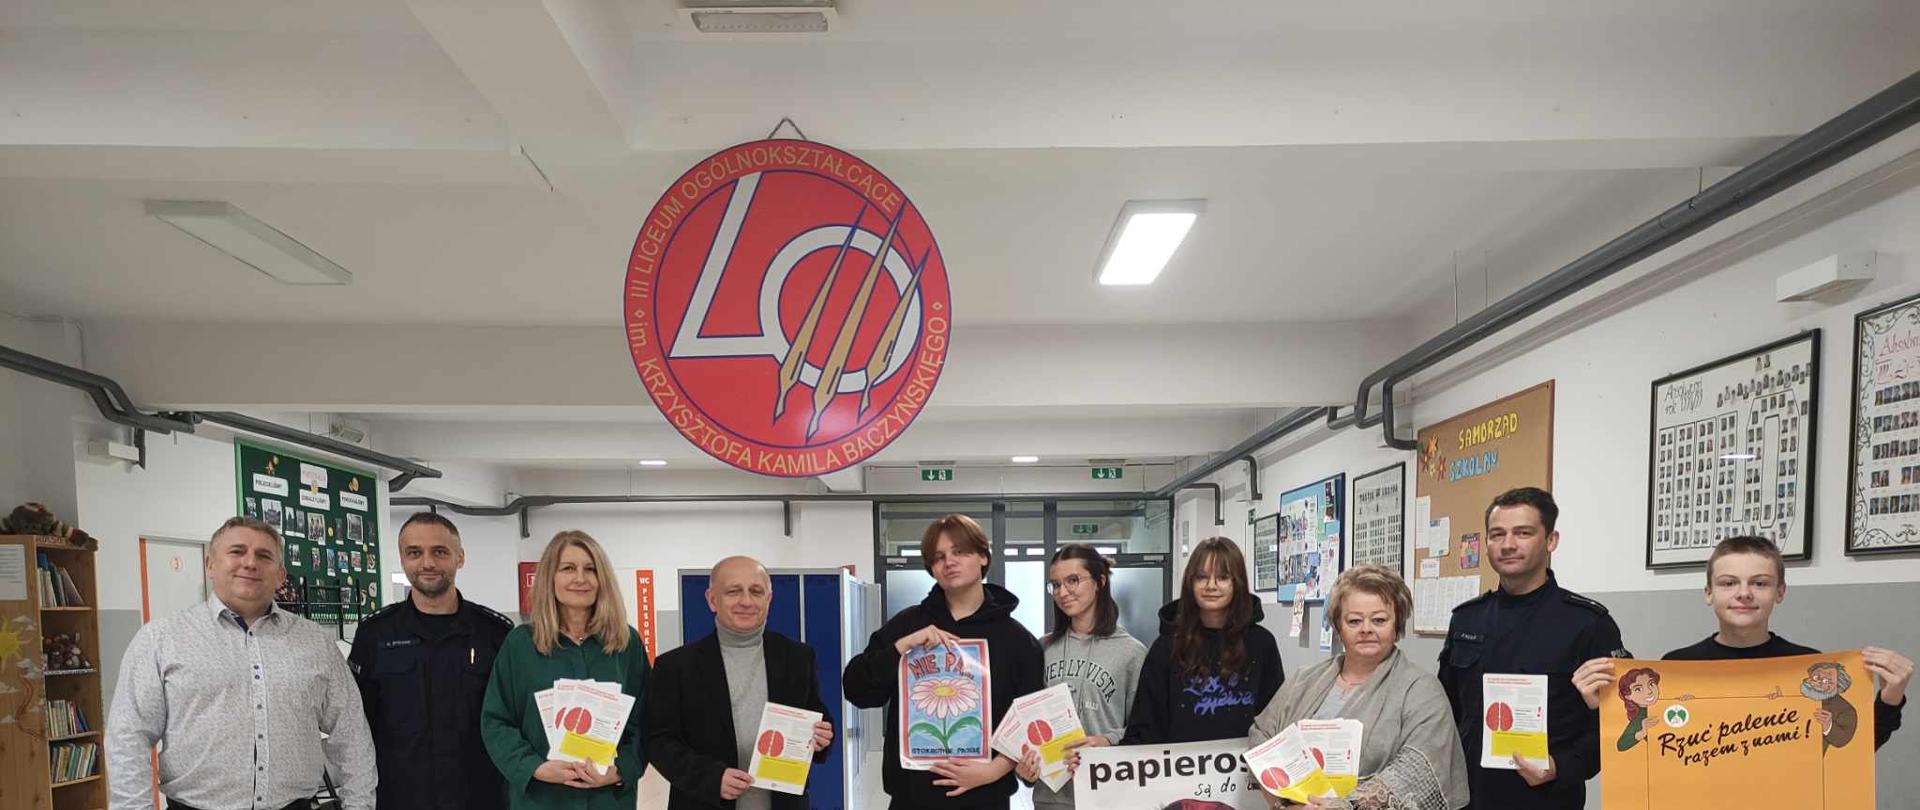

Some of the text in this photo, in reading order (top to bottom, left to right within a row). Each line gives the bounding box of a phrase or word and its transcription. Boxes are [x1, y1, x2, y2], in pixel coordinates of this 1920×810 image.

[631, 146, 900, 299] III LICEUM OGÓLNOKSZTAŁCĄCE
[630, 316, 948, 474] im. KRZYSZTOFA KAMILA BACZYŃSKIEGO
[642, 588, 650, 653] PERSONEL
[1086, 661, 1116, 703] VISTA
[1657, 708, 1801, 758] Rzuć palenie
[1684, 743, 1738, 766] razem
[1741, 740, 1750, 756] z
[1220, 776, 1237, 792] do
